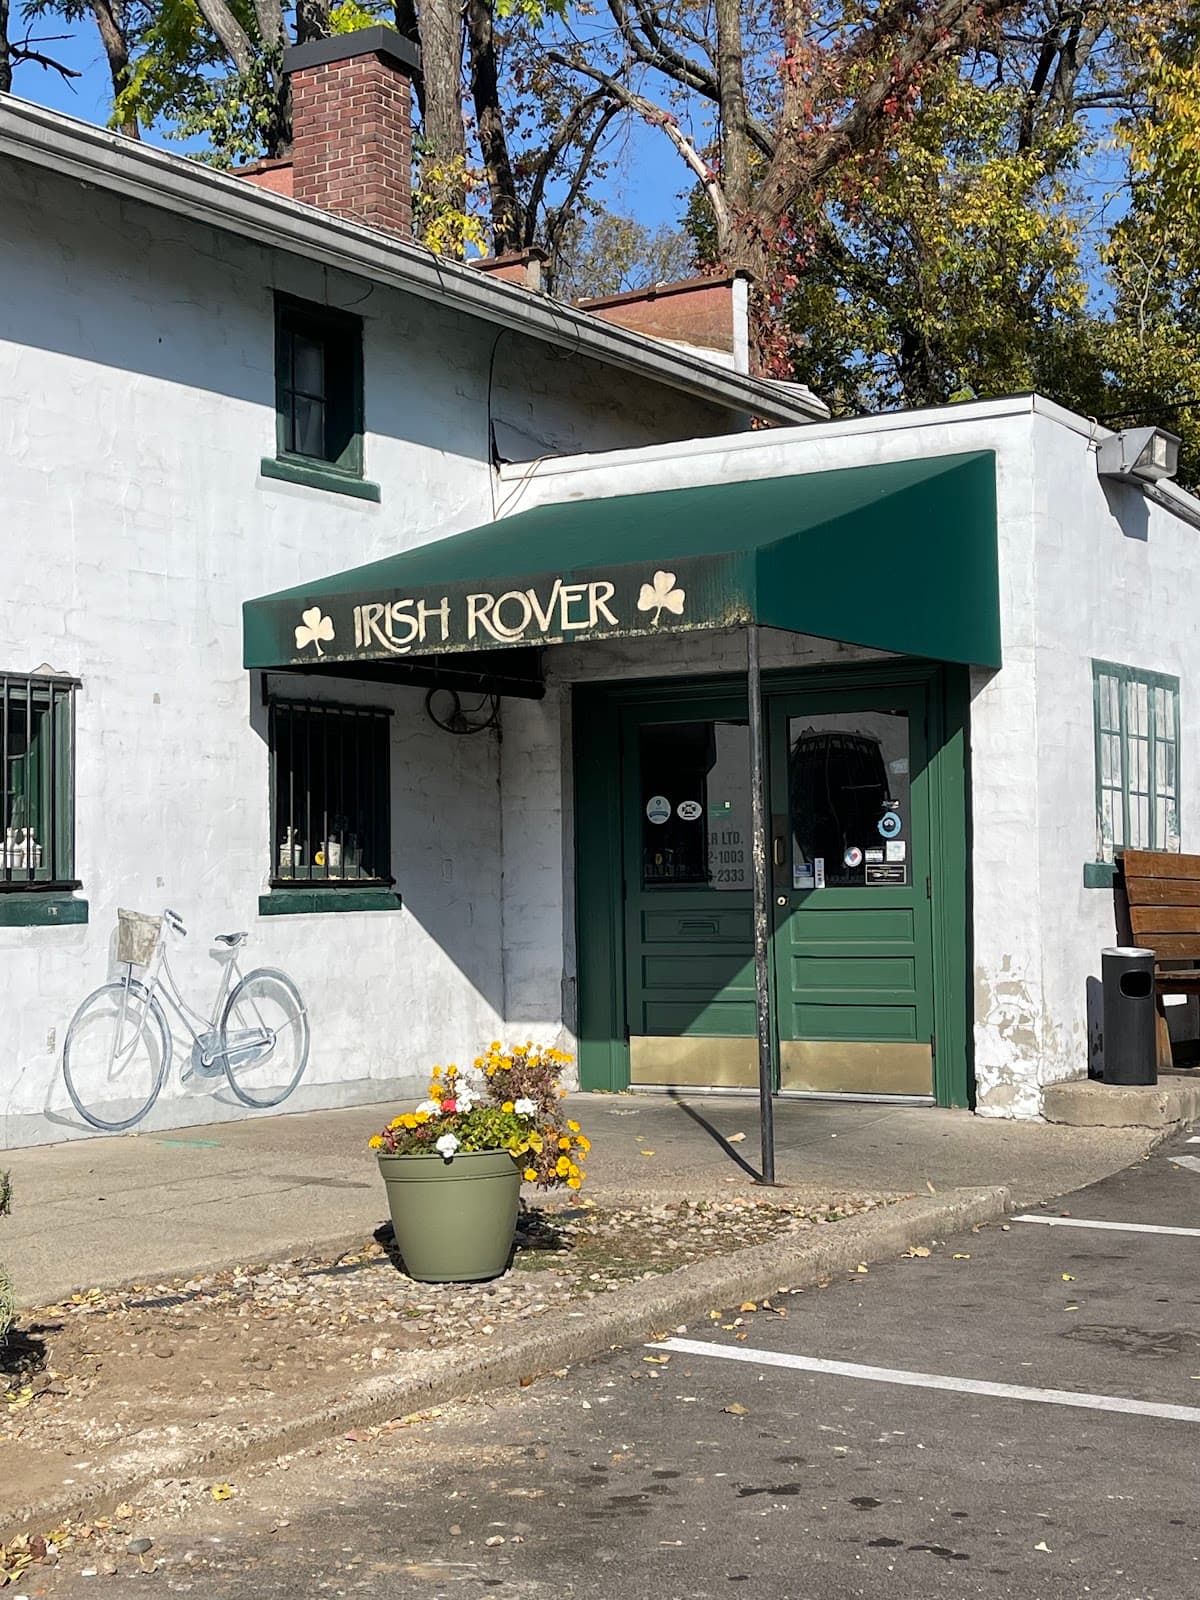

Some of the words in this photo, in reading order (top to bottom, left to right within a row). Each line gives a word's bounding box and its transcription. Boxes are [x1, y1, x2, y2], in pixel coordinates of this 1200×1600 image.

[353, 596, 451, 653] IRISH
[465, 578, 619, 643] ROVER
[721, 831, 744, 845] LTD.
